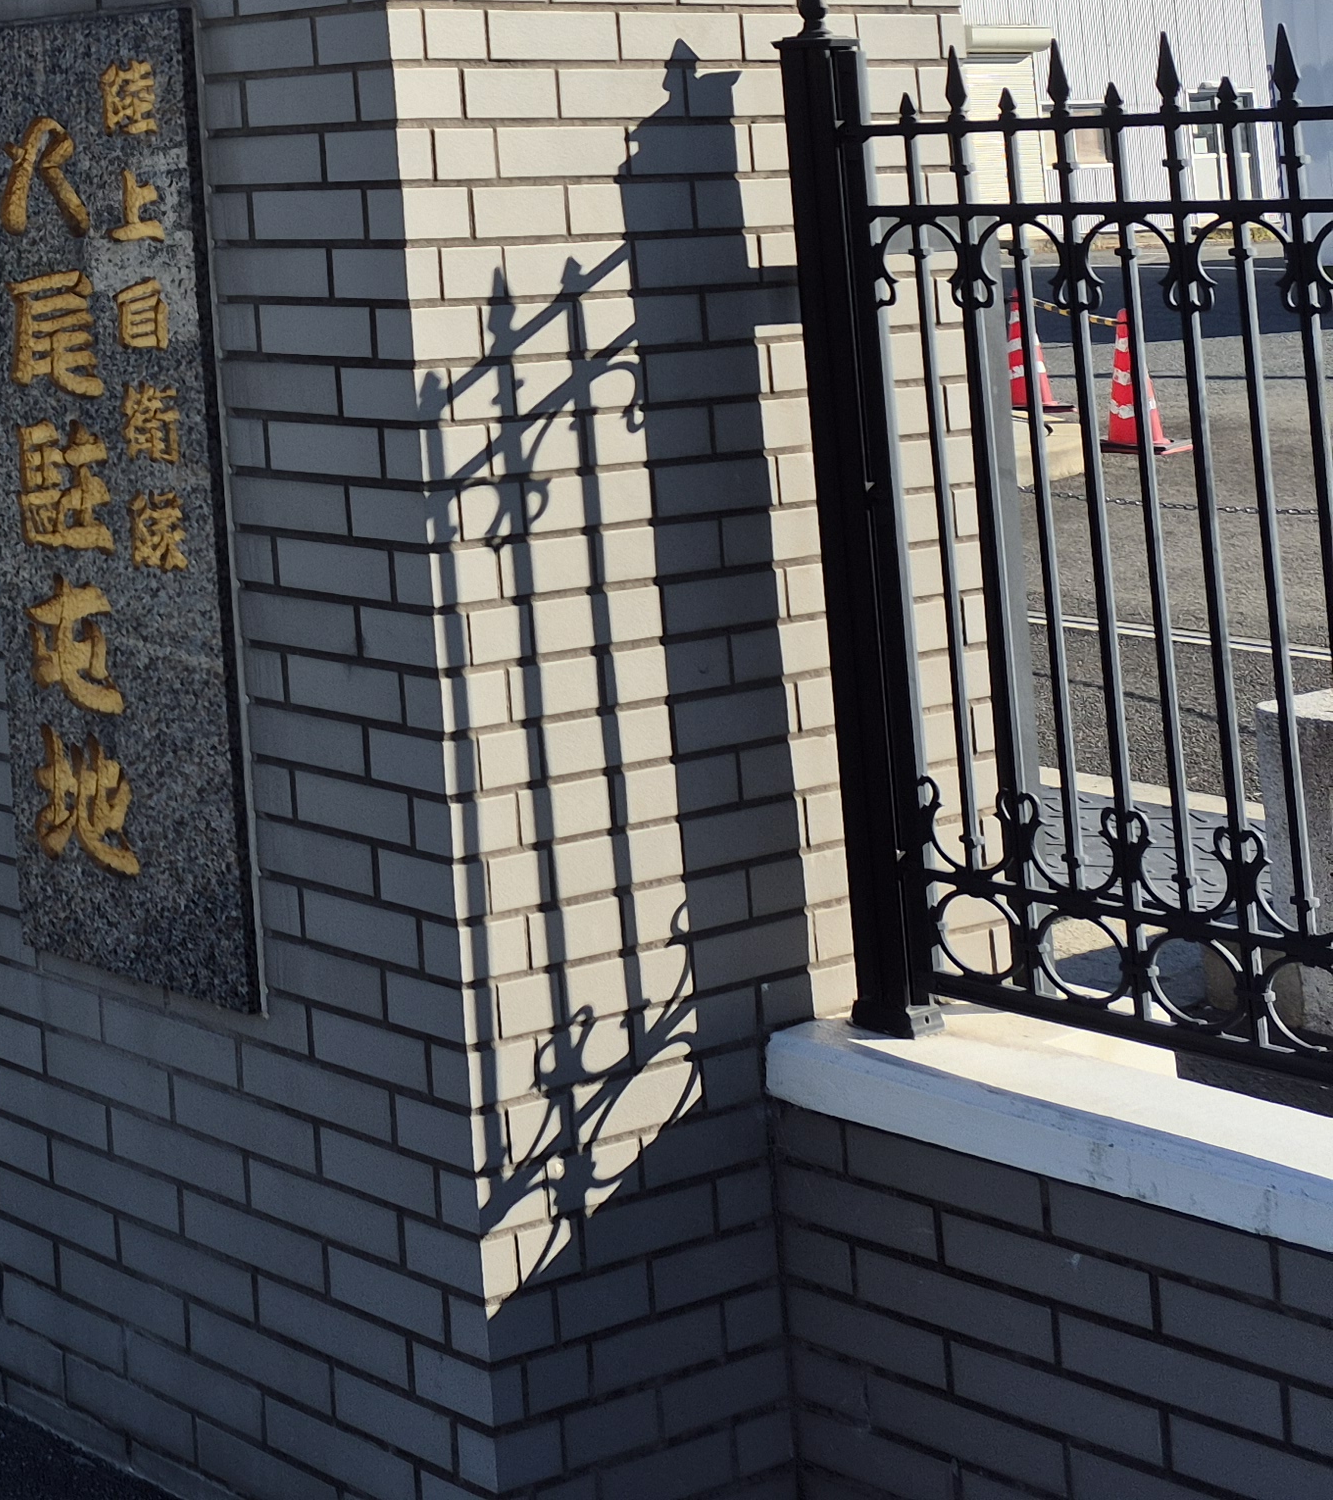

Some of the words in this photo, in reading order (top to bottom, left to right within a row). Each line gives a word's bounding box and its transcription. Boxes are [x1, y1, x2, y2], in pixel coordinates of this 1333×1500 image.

[0, 115, 140, 878] 八尾駐屯地
[100, 58, 188, 572] 陸上自衛隊
